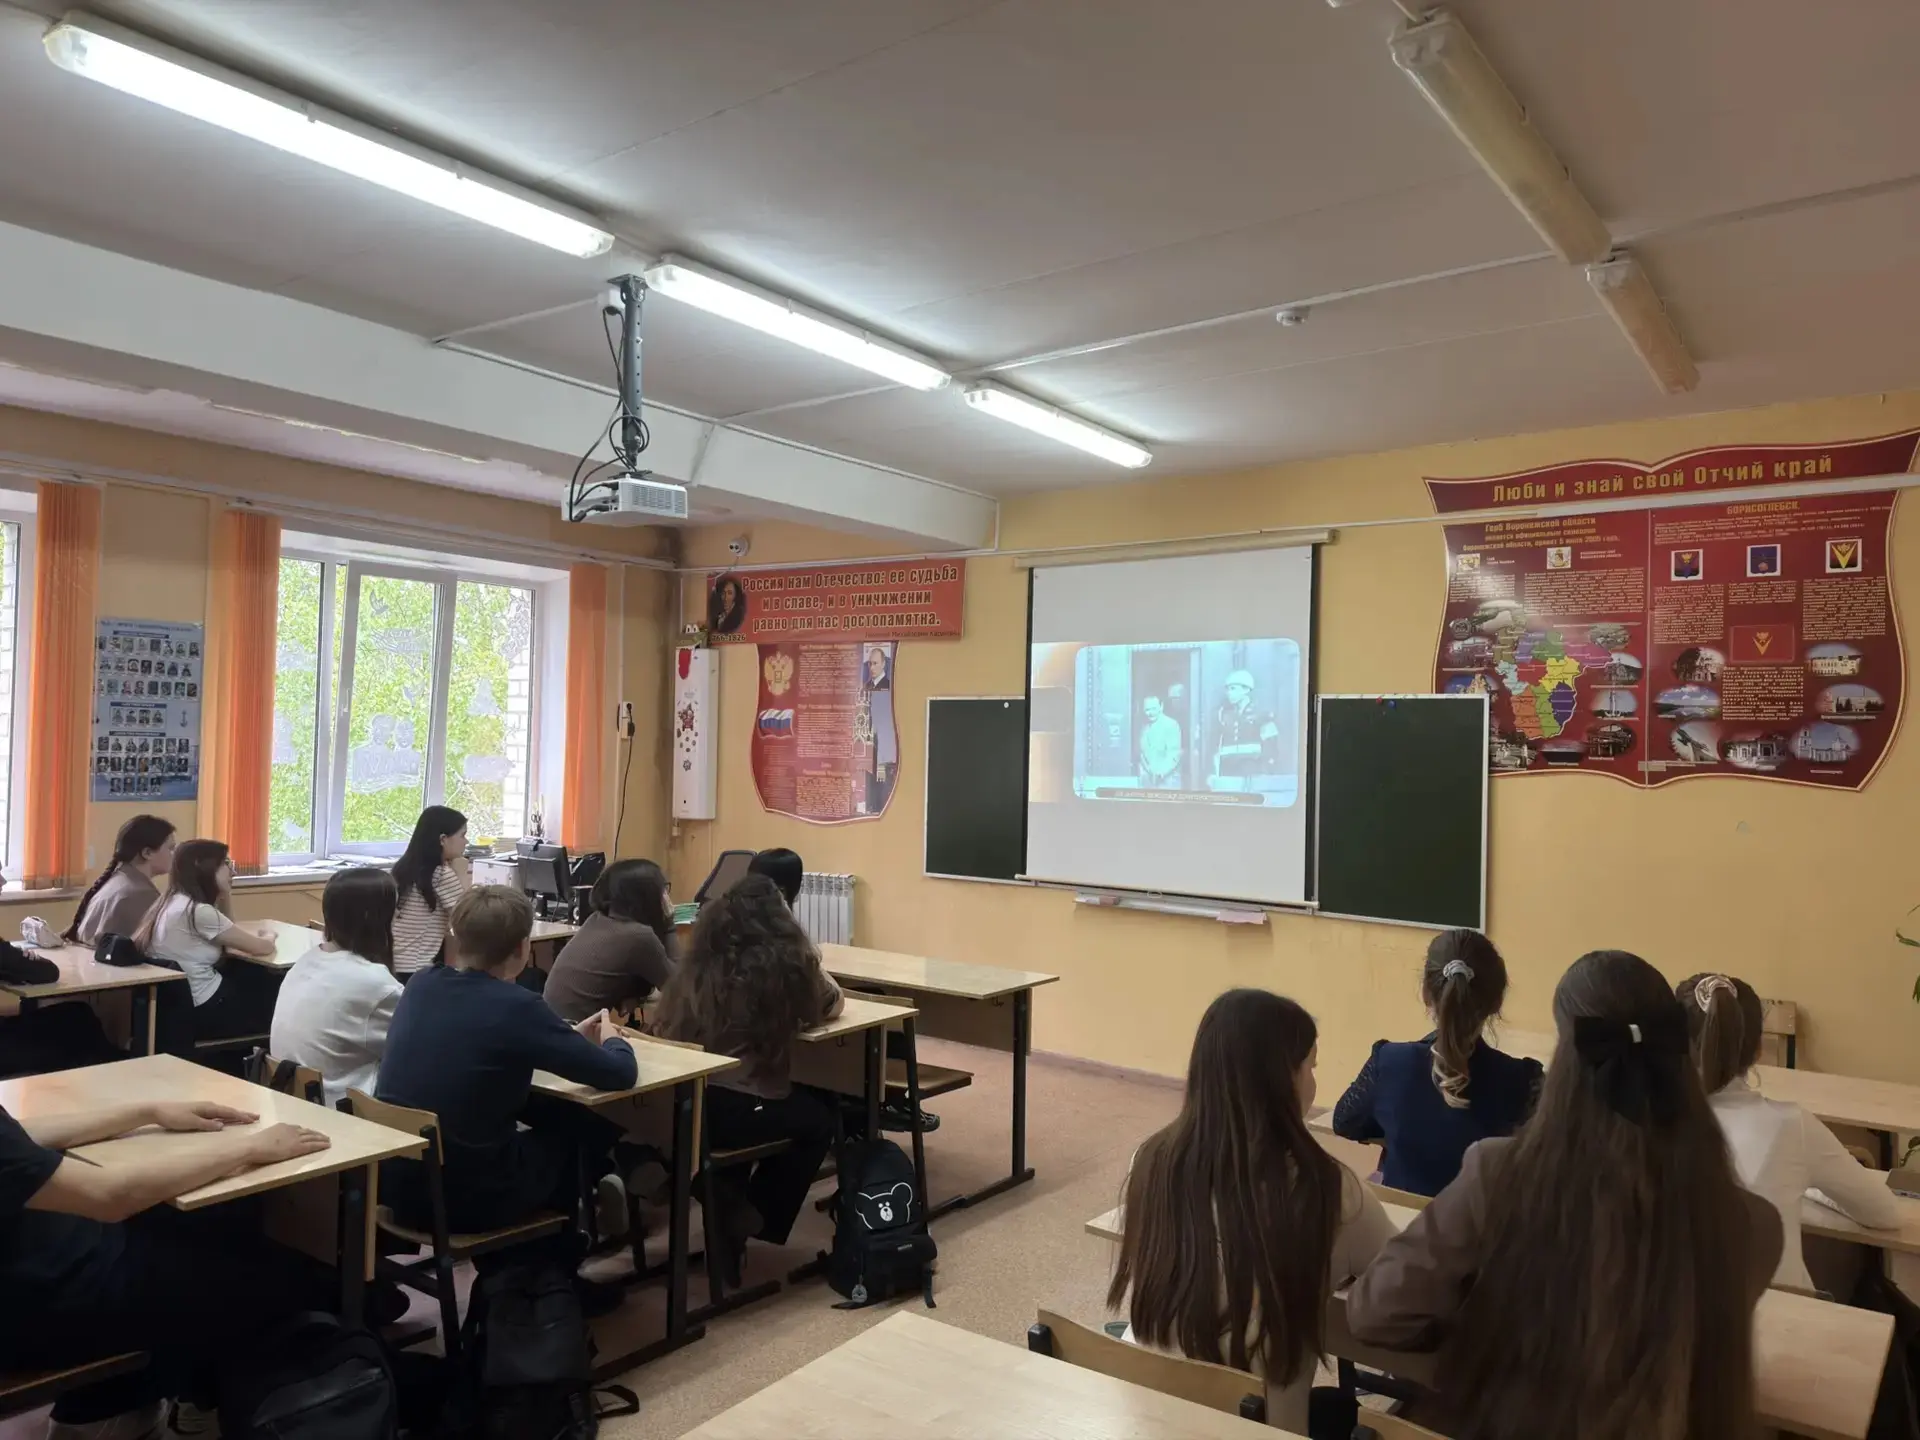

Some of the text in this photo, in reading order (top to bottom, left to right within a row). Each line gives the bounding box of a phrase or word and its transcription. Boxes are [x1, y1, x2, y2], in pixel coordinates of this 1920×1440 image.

[1492, 454, 1832, 502] Люби и знай свой Отчий край
[1485, 523, 1503, 532] Герб
[742, 564, 957, 592] Россия нам Отечество: ее судьба
[762, 590, 932, 611] и в славе, и в уничижении
[753, 612, 941, 633] равно для нас достопамятна.
